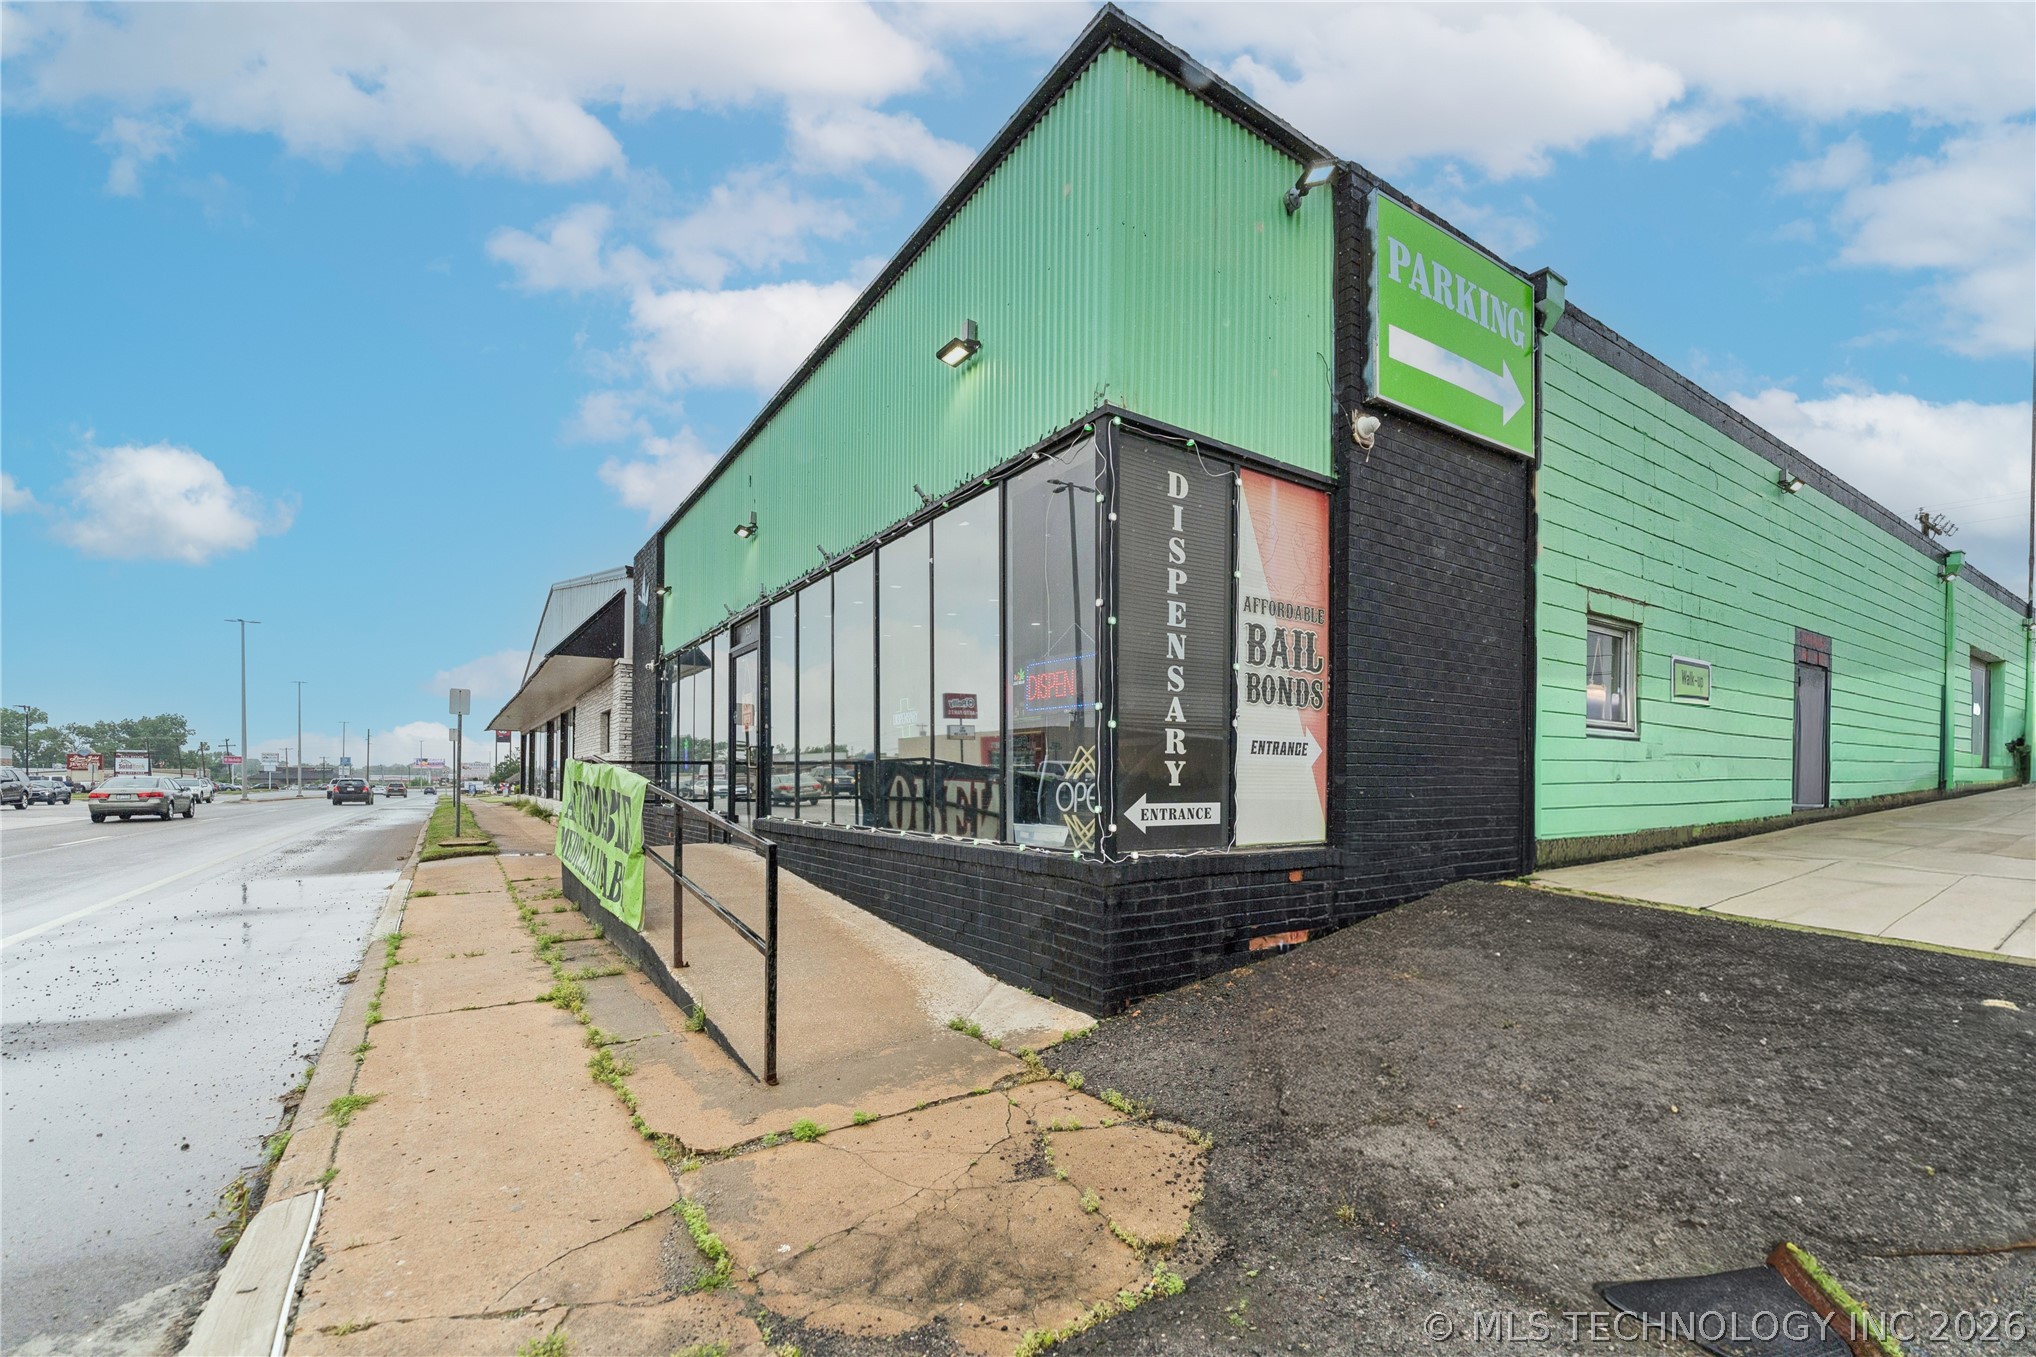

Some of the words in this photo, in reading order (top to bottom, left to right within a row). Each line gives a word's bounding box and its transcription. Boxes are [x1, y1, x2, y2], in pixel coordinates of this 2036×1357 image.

[1387, 235, 1526, 349] PARKING
[1243, 595, 1325, 625] AFFORDABLE
[1164, 470, 1189, 787] DISPENSARY
[1245, 622, 1325, 674] BAIL
[1245, 671, 1325, 710] BONDS
[1681, 669, 1704, 694] Walk-up
[1250, 739, 1309, 757] ENTRANCE
[1140, 806, 1212, 822] ENTRANCE
